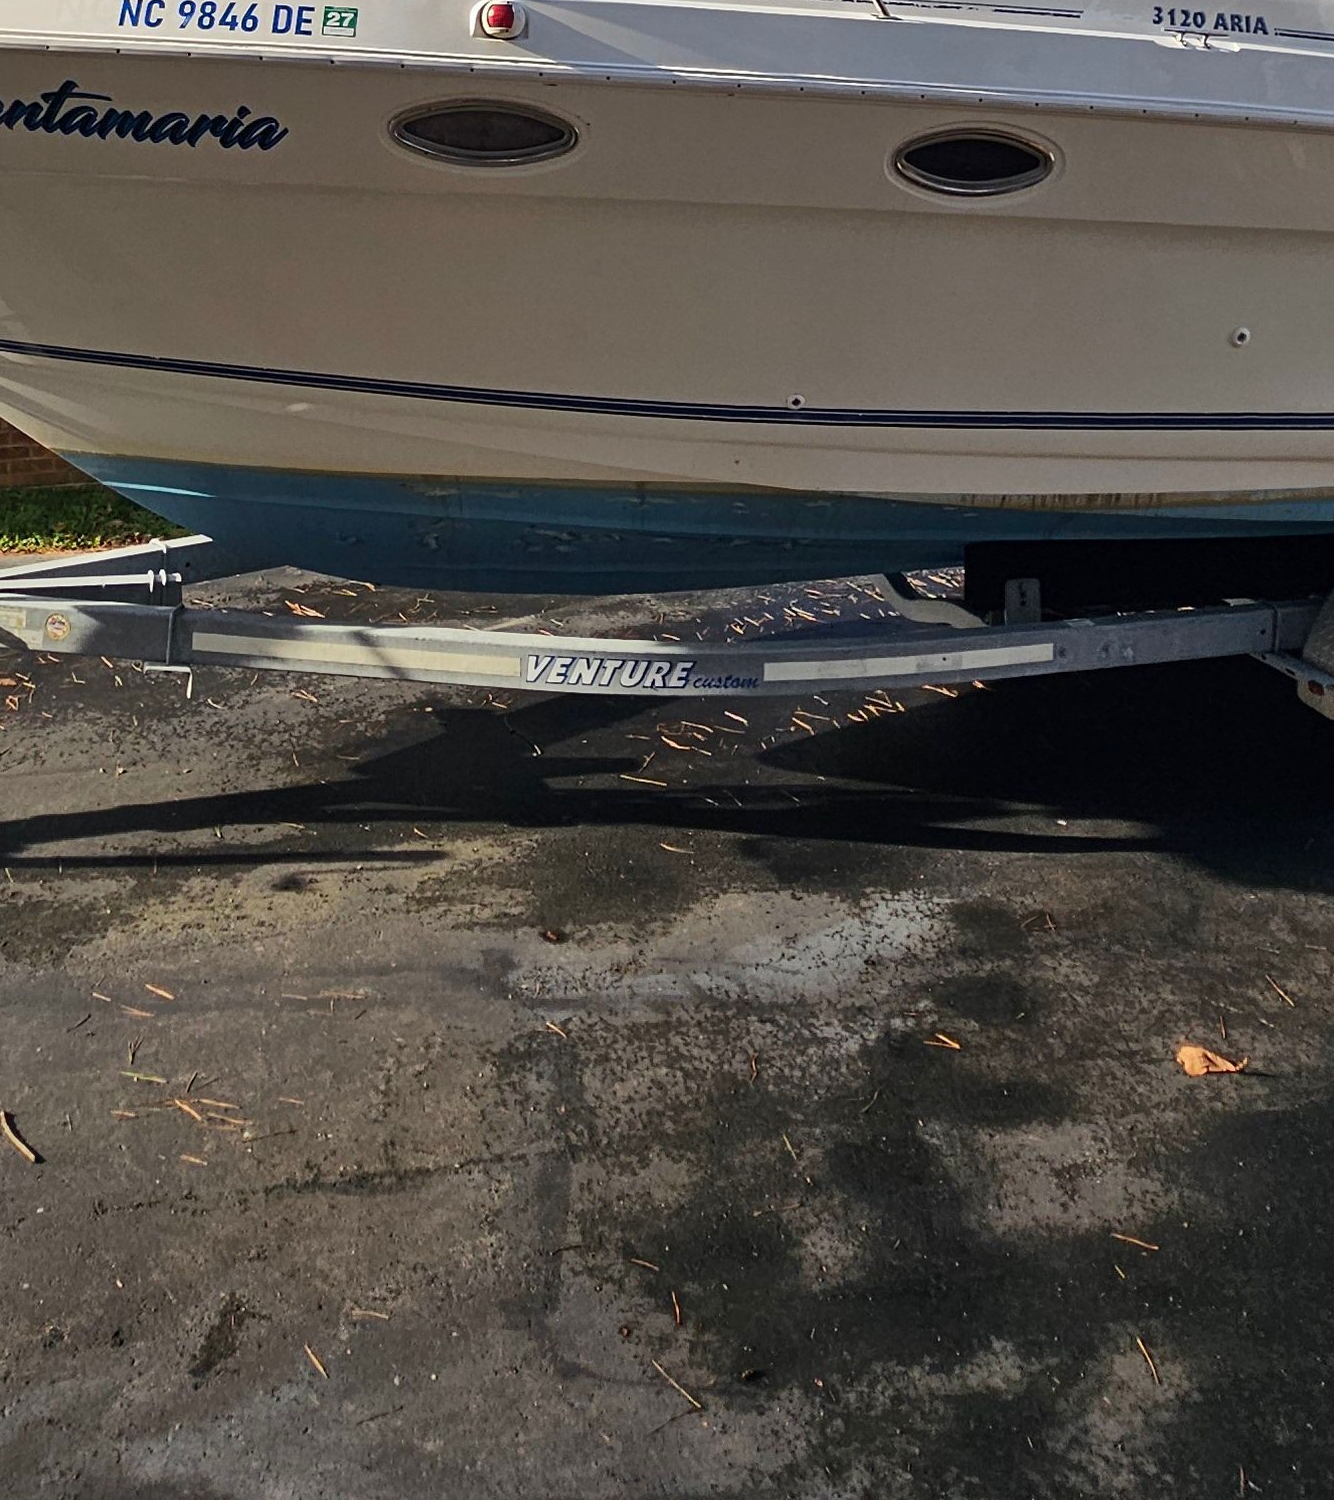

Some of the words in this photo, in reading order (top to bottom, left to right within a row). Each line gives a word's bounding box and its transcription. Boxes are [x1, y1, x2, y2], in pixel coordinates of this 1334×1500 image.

[178, 0, 259, 31] 9846
[271, 4, 315, 36] DE
[326, 11, 355, 27] 27
[1152, 6, 1206, 29] 3120
[1214, 13, 1269, 35] ARIA
[525, 654, 695, 689] VENTURE
[692, 674, 760, 689] custom
